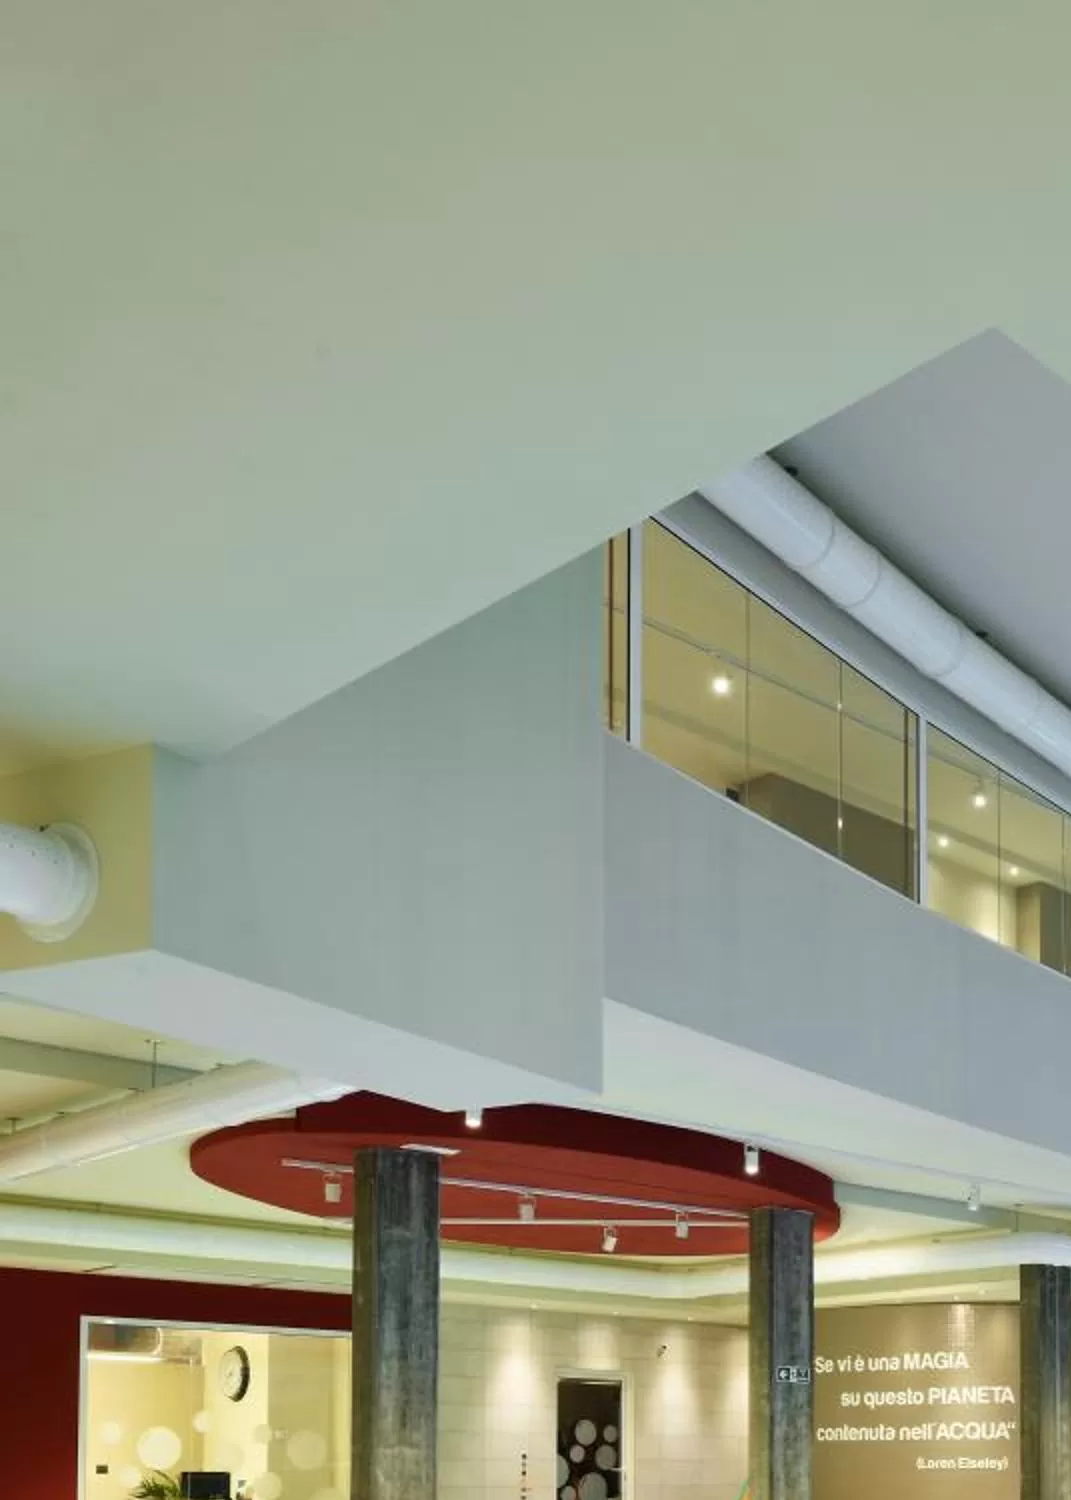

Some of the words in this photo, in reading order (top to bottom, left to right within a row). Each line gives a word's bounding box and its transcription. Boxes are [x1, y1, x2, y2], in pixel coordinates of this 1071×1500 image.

[815, 1356, 833, 1373] Se
[837, 1355, 852, 1372] vi
[868, 1356, 900, 1372] una
[903, 1350, 970, 1370] MAGIA
[840, 1391, 861, 1407] su
[863, 1387, 924, 1410] questo
[927, 1385, 1016, 1405] PIANETA
[816, 1423, 896, 1441] contenuta
[915, 1456, 957, 1471] (Loren
